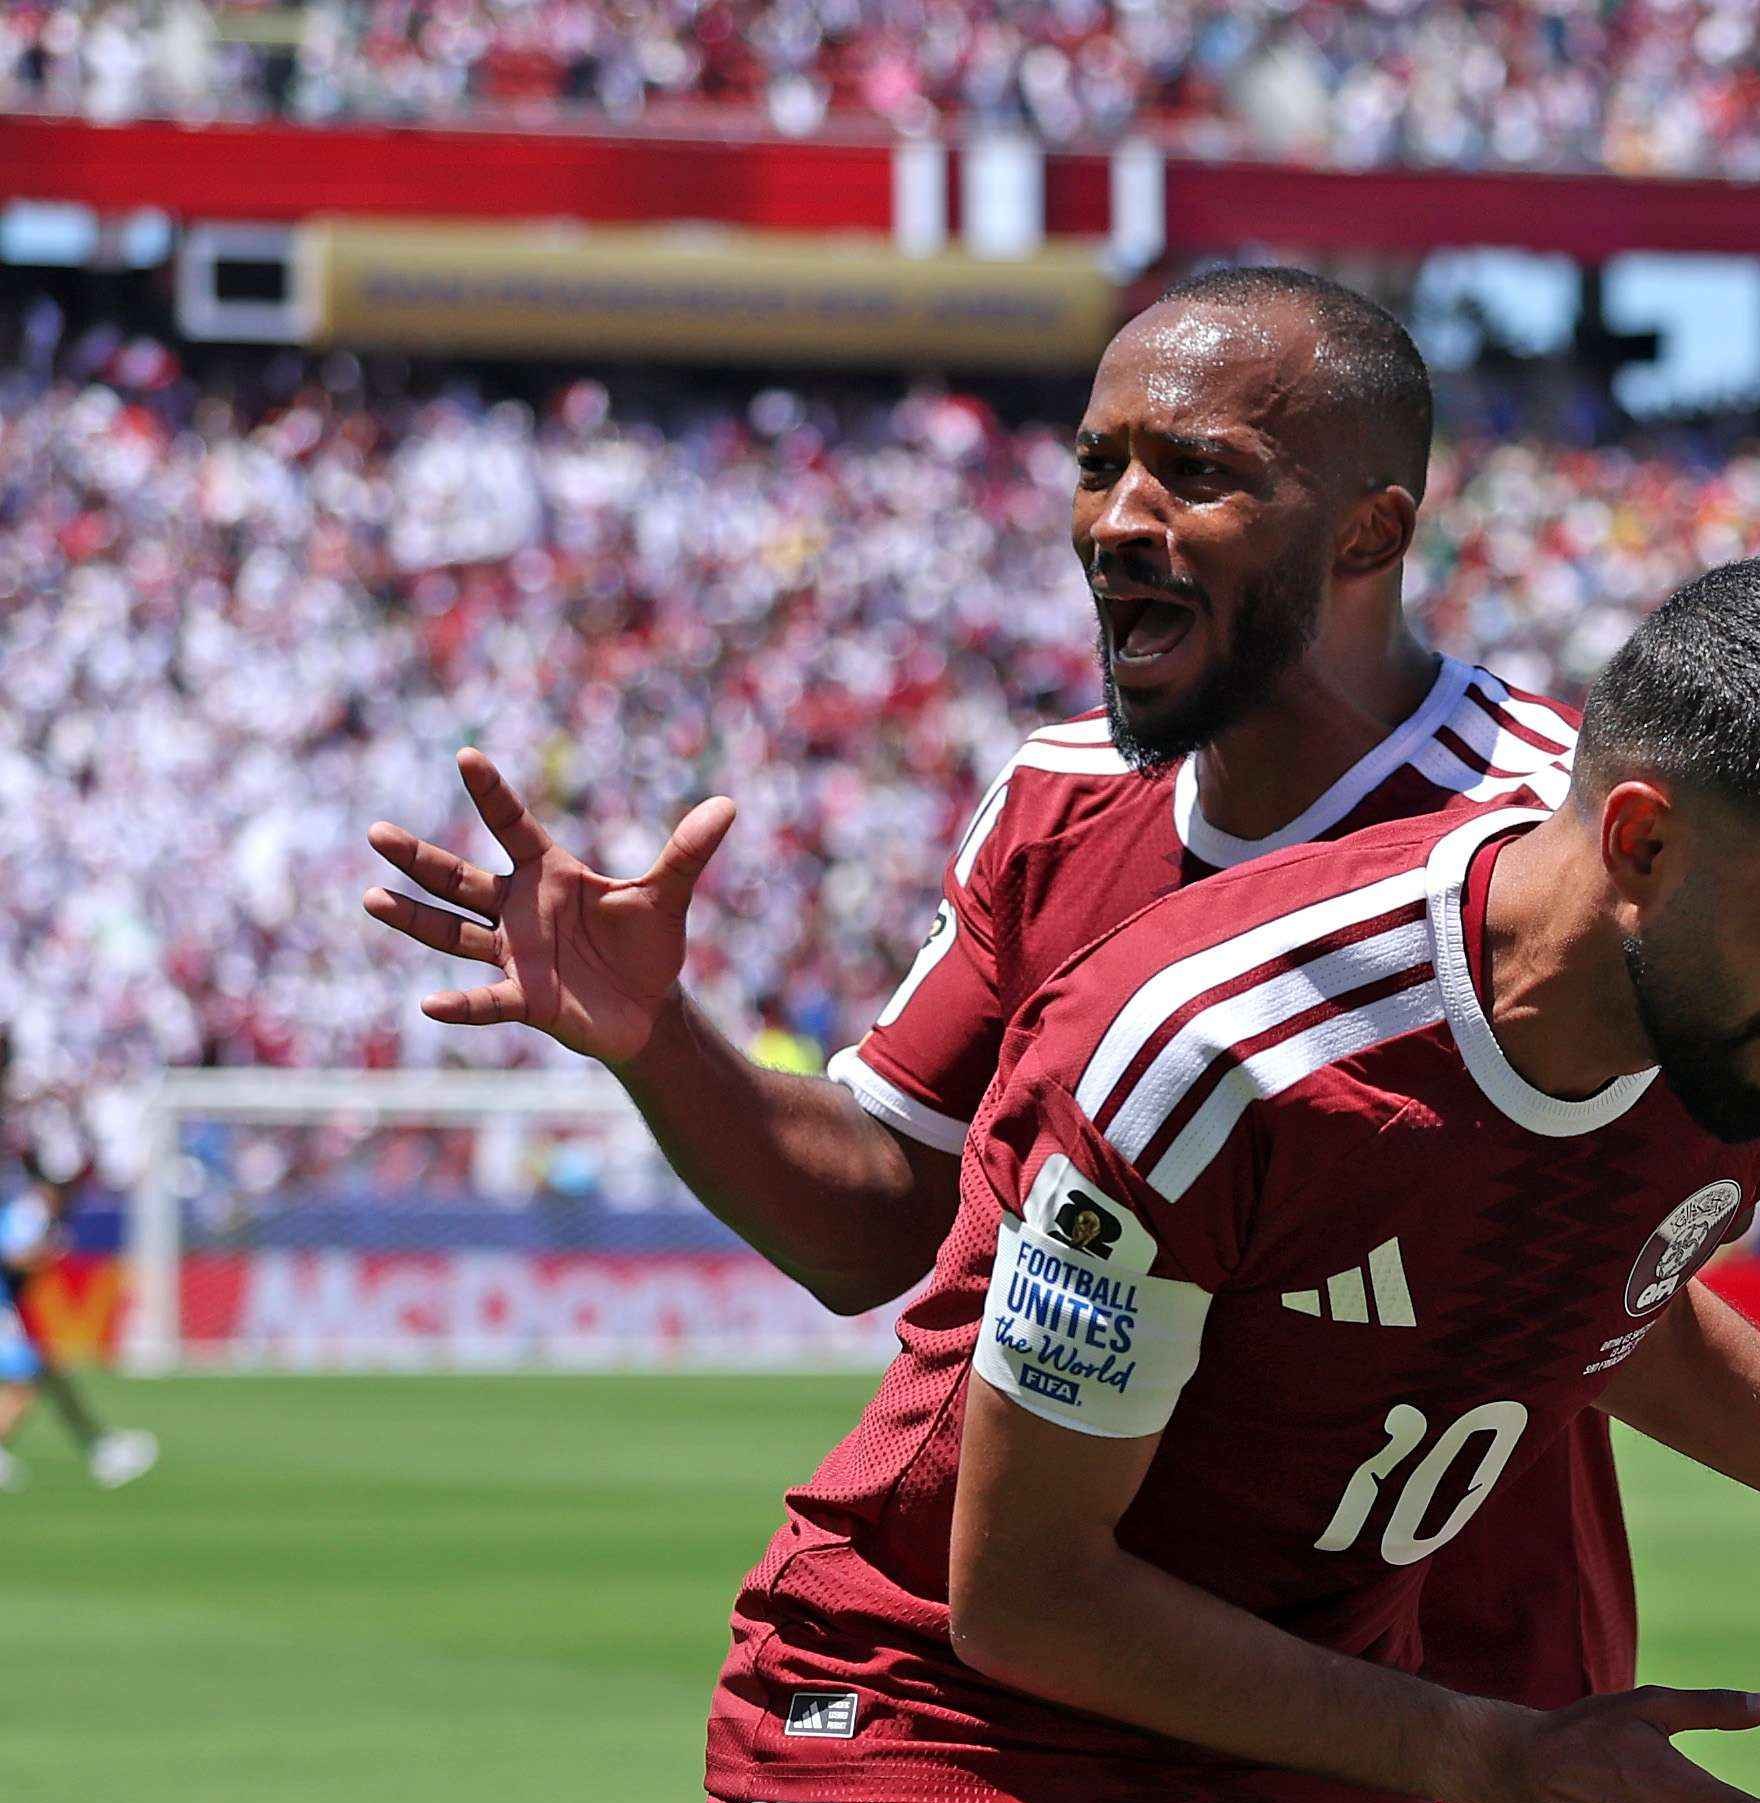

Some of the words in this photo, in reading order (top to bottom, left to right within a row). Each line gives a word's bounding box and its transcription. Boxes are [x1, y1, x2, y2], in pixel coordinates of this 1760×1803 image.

[1007, 1271, 1136, 1354] UNITES
[1017, 1241, 1138, 1314] FOOTBALL
[995, 1315, 1032, 1355] the
[1037, 1333, 1136, 1394] World
[1022, 1367, 1076, 1401] FIFA
[1314, 1401, 1528, 1566] 10
